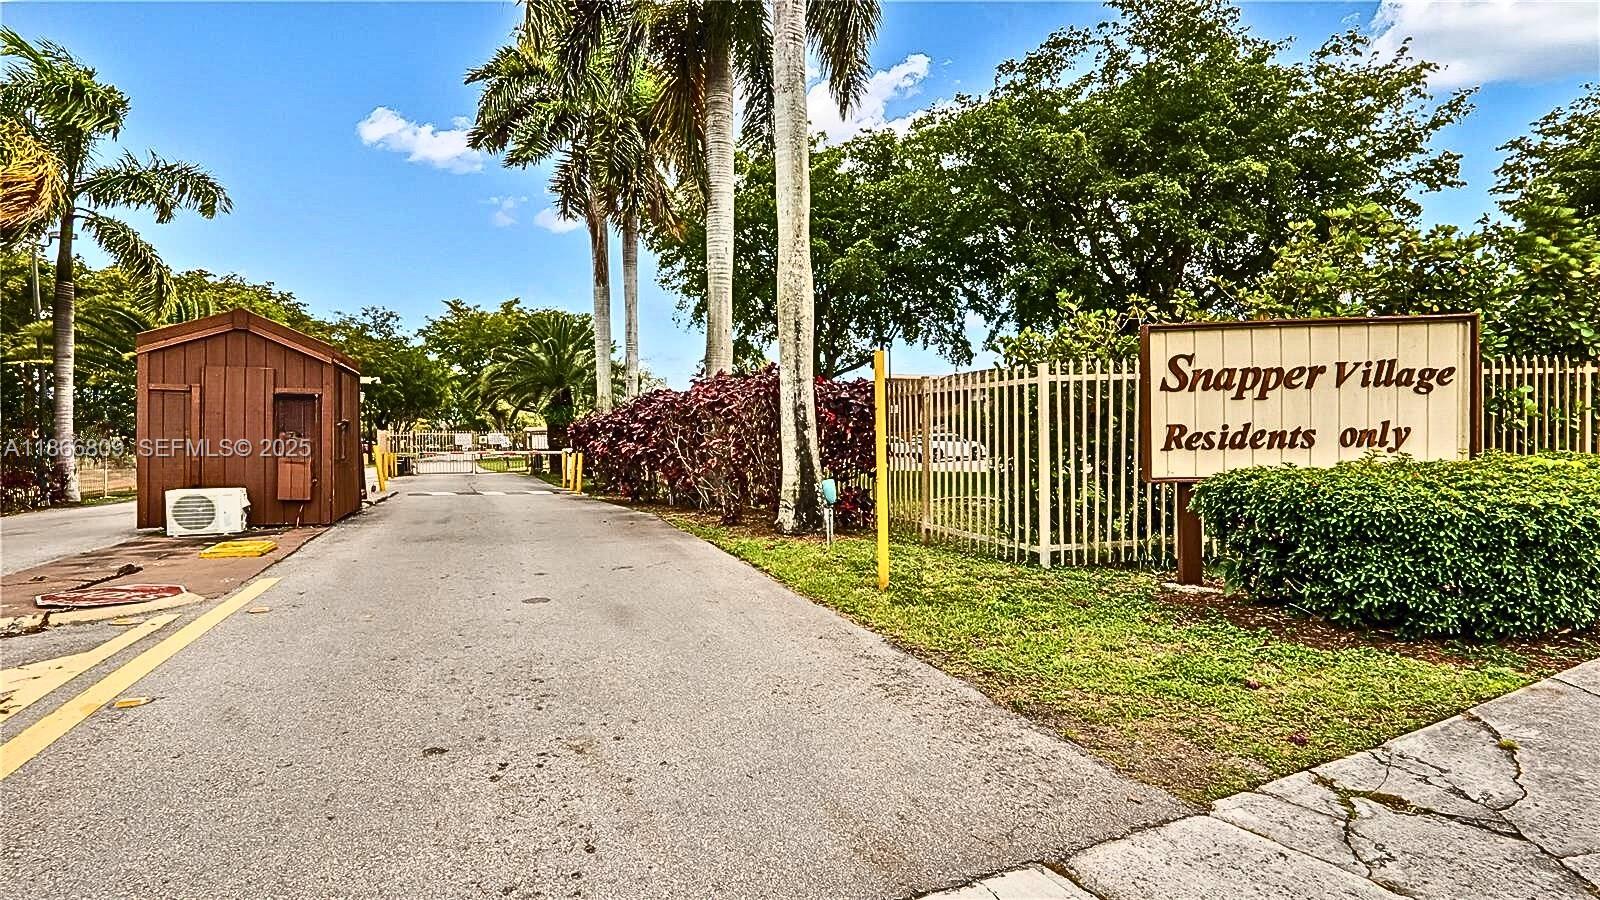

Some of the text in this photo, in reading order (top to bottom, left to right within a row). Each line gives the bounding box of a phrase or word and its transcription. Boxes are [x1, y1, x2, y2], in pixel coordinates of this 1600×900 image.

[1160, 353, 1457, 401] Snapper Village
[1161, 420, 1412, 453] Residents only
